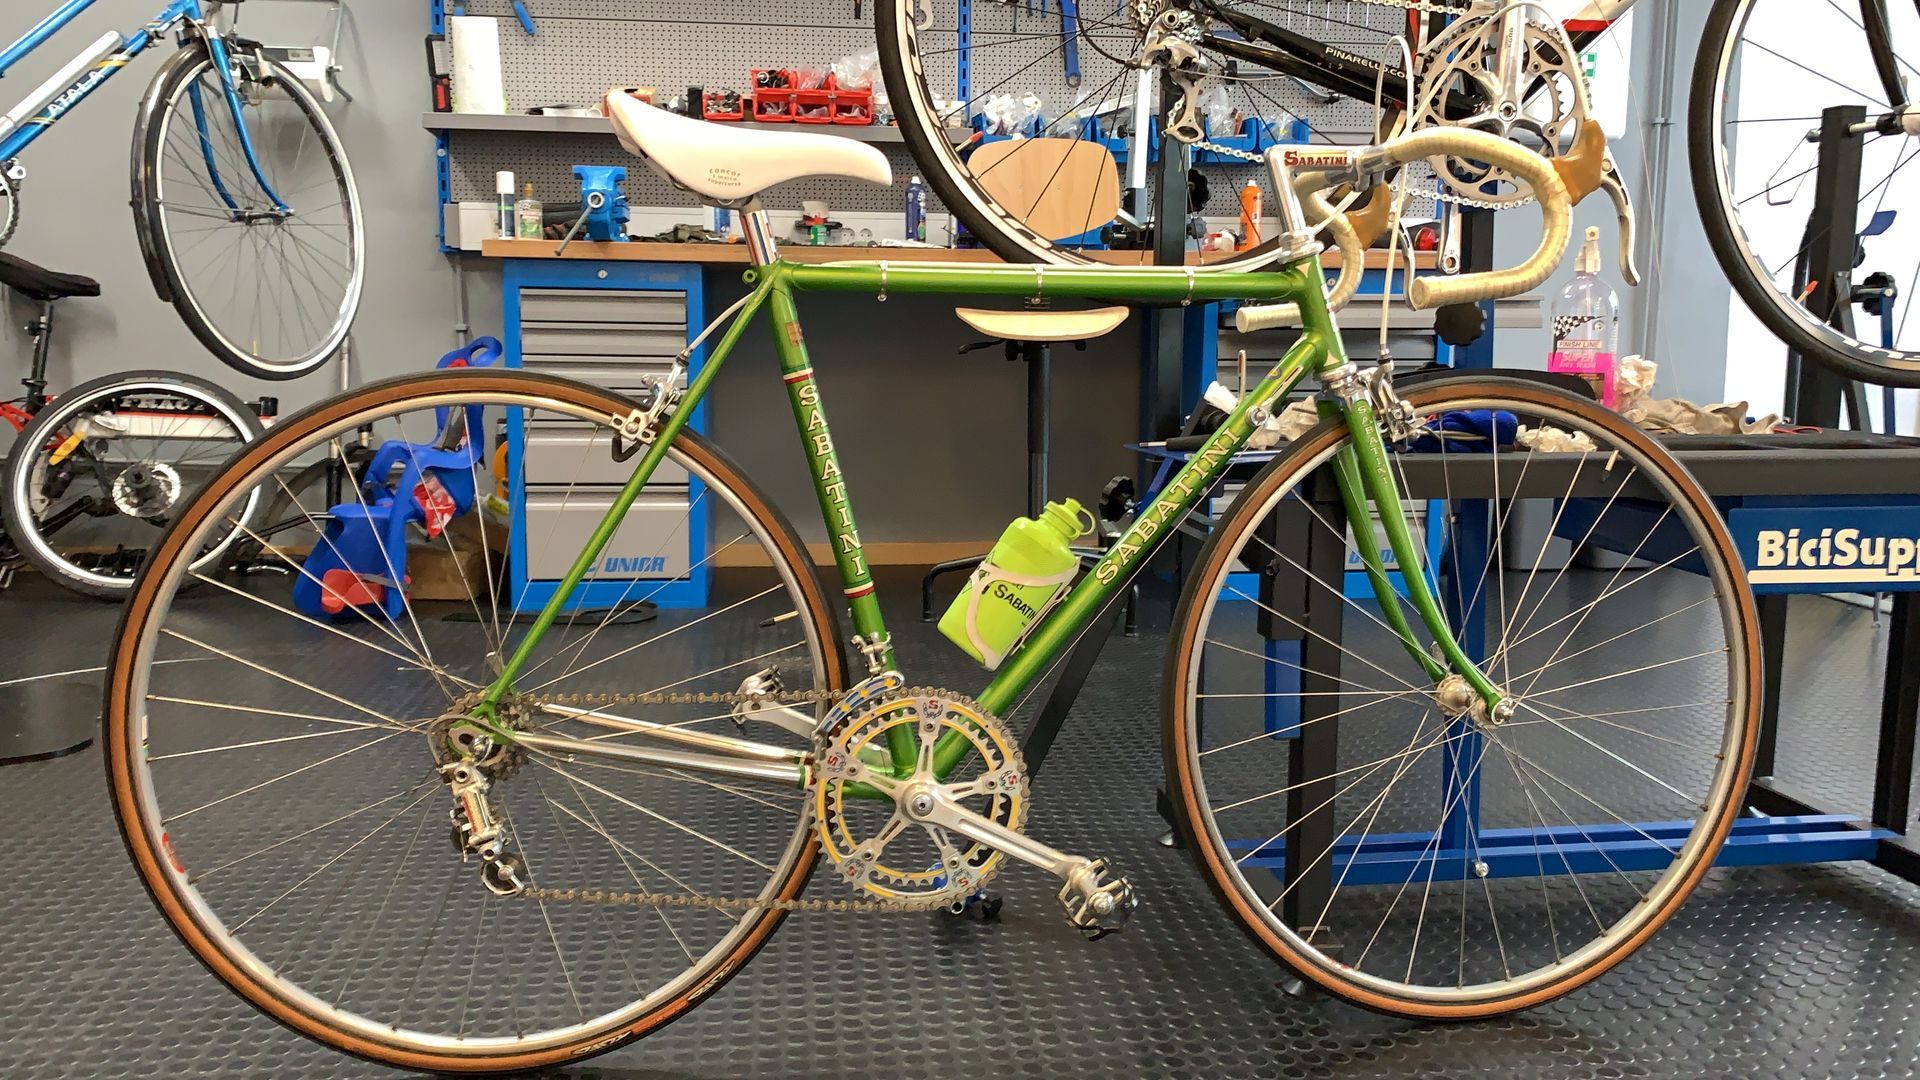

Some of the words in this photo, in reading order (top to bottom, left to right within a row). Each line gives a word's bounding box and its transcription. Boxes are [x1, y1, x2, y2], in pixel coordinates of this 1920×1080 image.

[47, 69, 105, 118] ATALA
[1284, 151, 1347, 167] SABATINI
[1357, 405, 1388, 484] SABATINI
[798, 384, 866, 577] SABATINI
[1095, 427, 1241, 585] SABATINI
[1757, 528, 1920, 575] BiciSup
